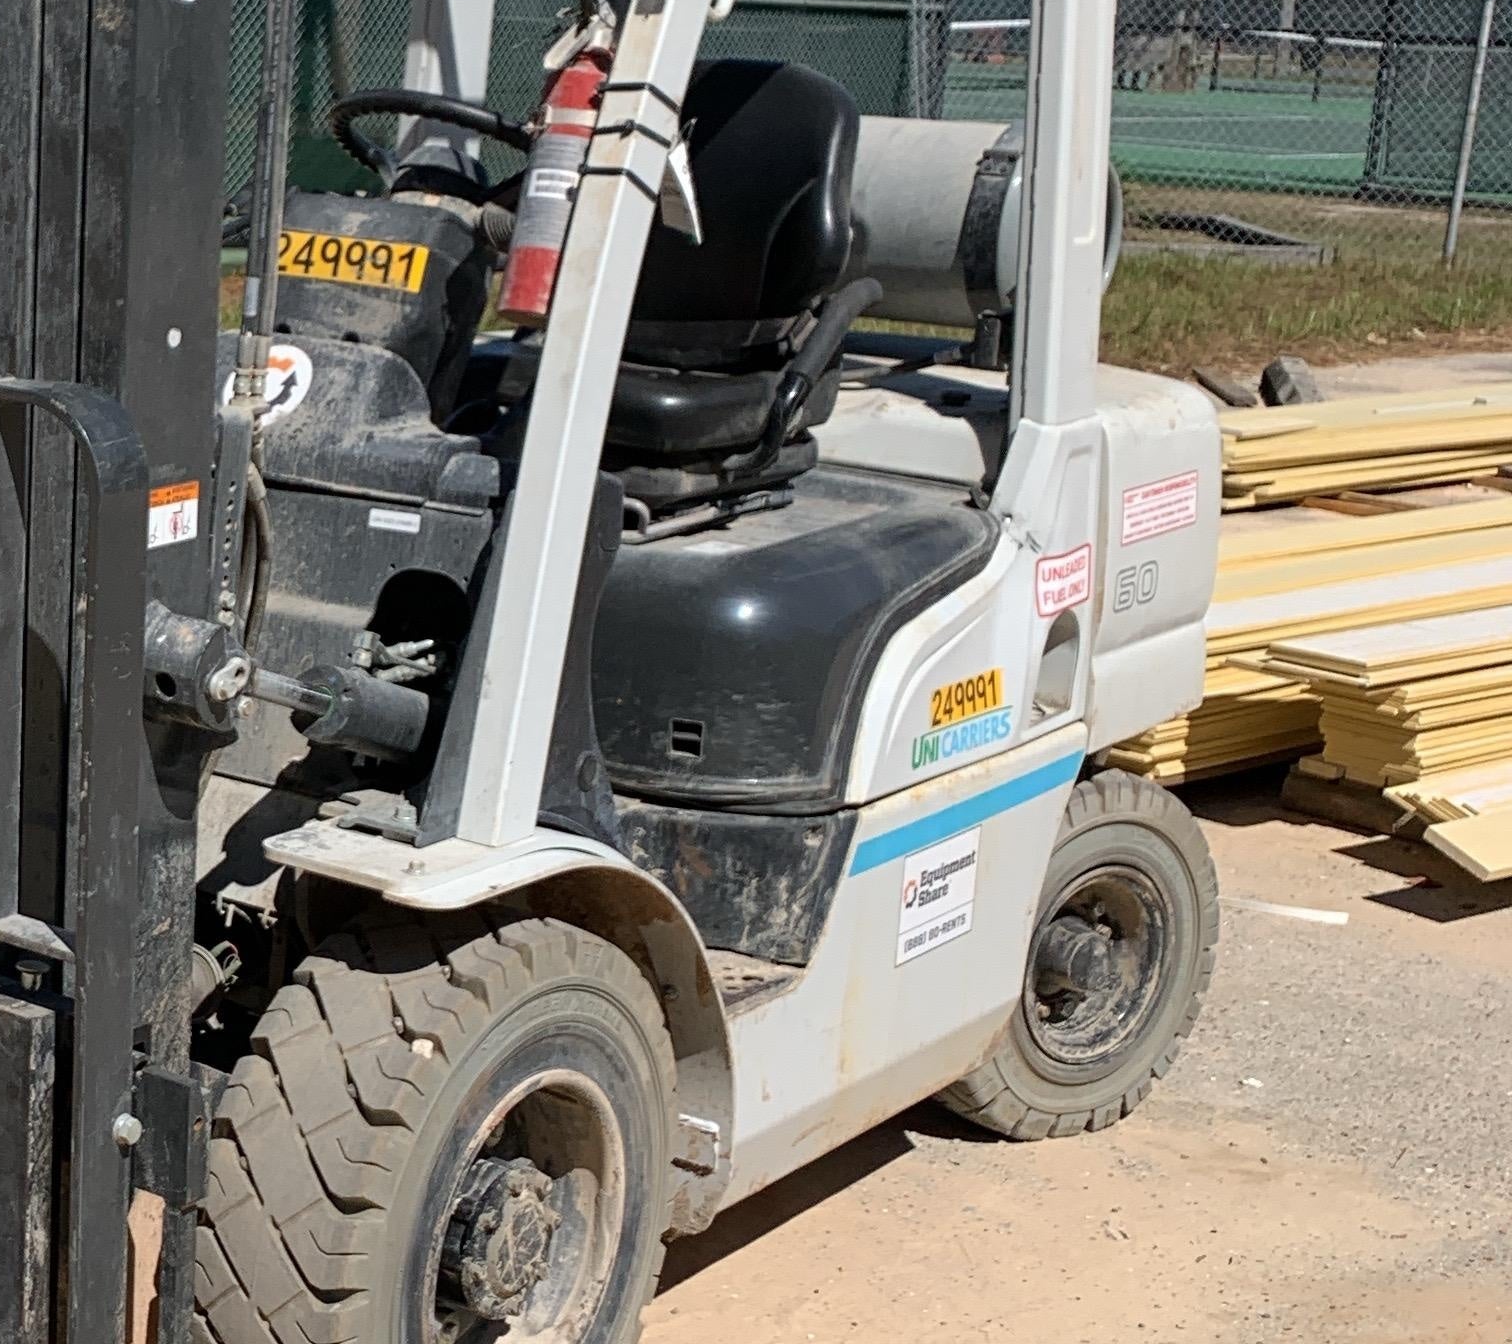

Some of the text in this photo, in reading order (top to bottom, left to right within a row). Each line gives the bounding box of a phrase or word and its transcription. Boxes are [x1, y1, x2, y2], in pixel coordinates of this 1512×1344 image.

[278, 233, 417, 288] 249991
[1042, 556, 1086, 582] UNLEADED
[931, 669, 997, 727] 249991
[919, 850, 976, 888] Equipment
[918, 882, 949, 907] Share
